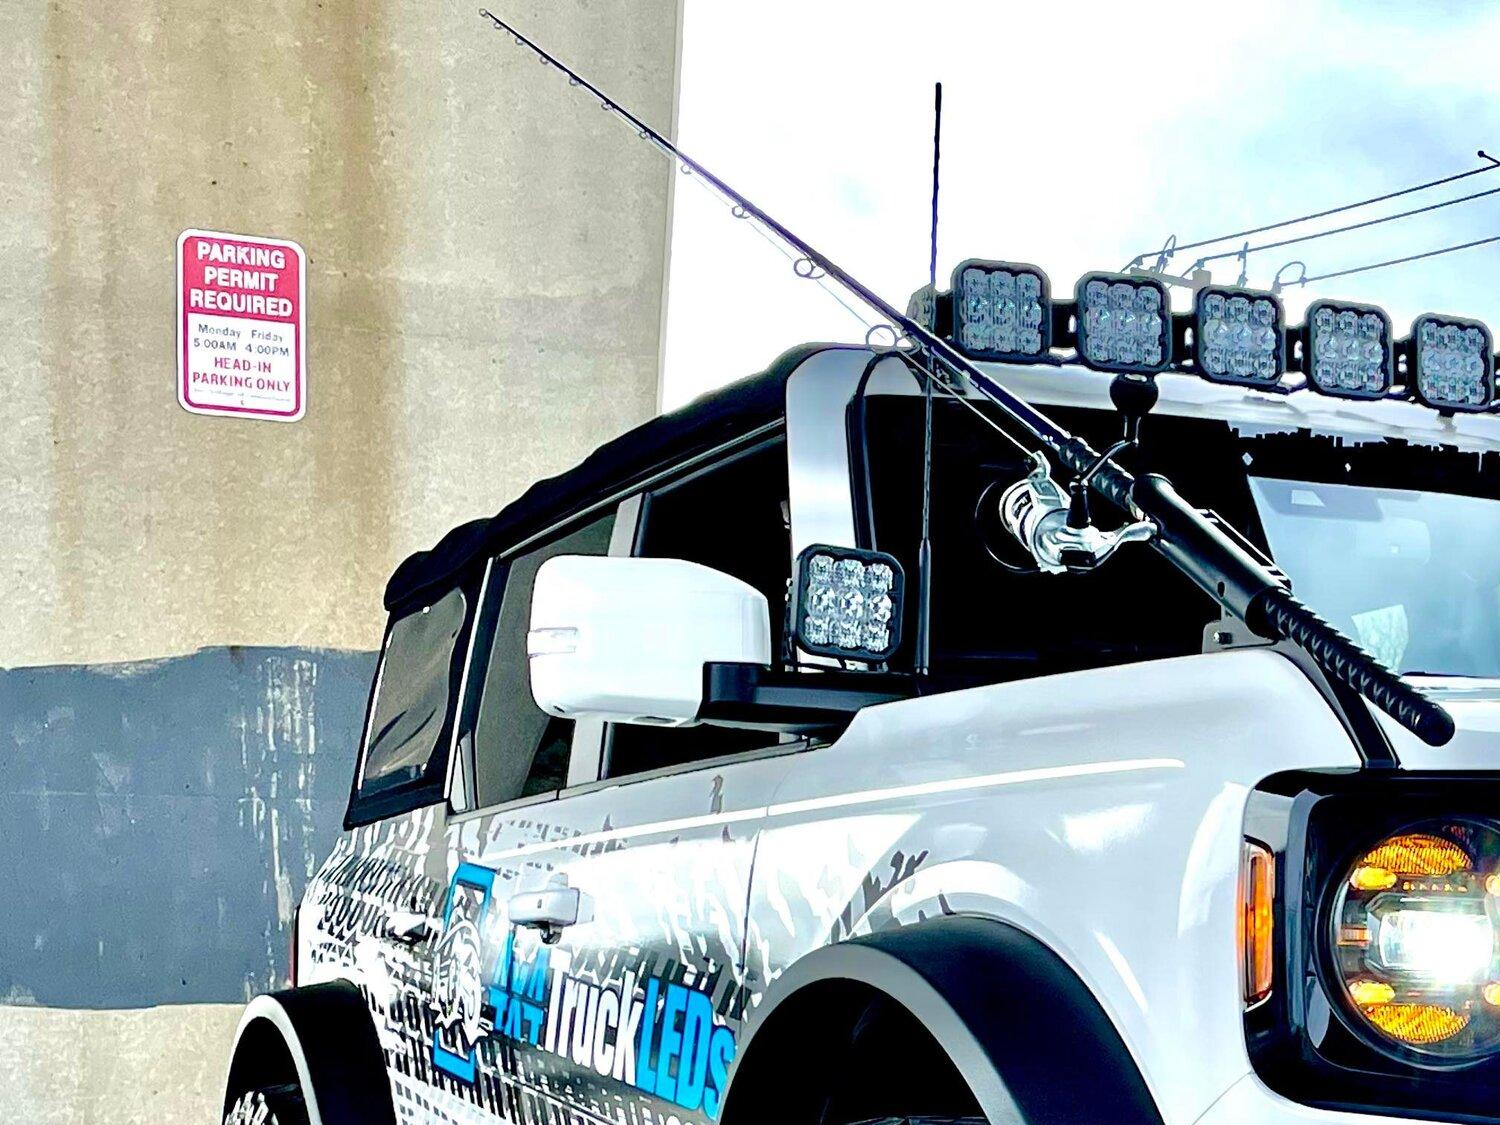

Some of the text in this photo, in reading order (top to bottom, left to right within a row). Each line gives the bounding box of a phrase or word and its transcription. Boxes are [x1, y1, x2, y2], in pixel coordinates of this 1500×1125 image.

[197, 241, 286, 269] PARKING
[204, 265, 279, 292] PERMIT
[189, 288, 293, 317] REQUIRED
[198, 323, 283, 343] Monday Friday
[193, 337, 289, 357] 500AM 400PM
[214, 356, 272, 373] HEAD-IN
[192, 371, 291, 392] PARKING ONLY
